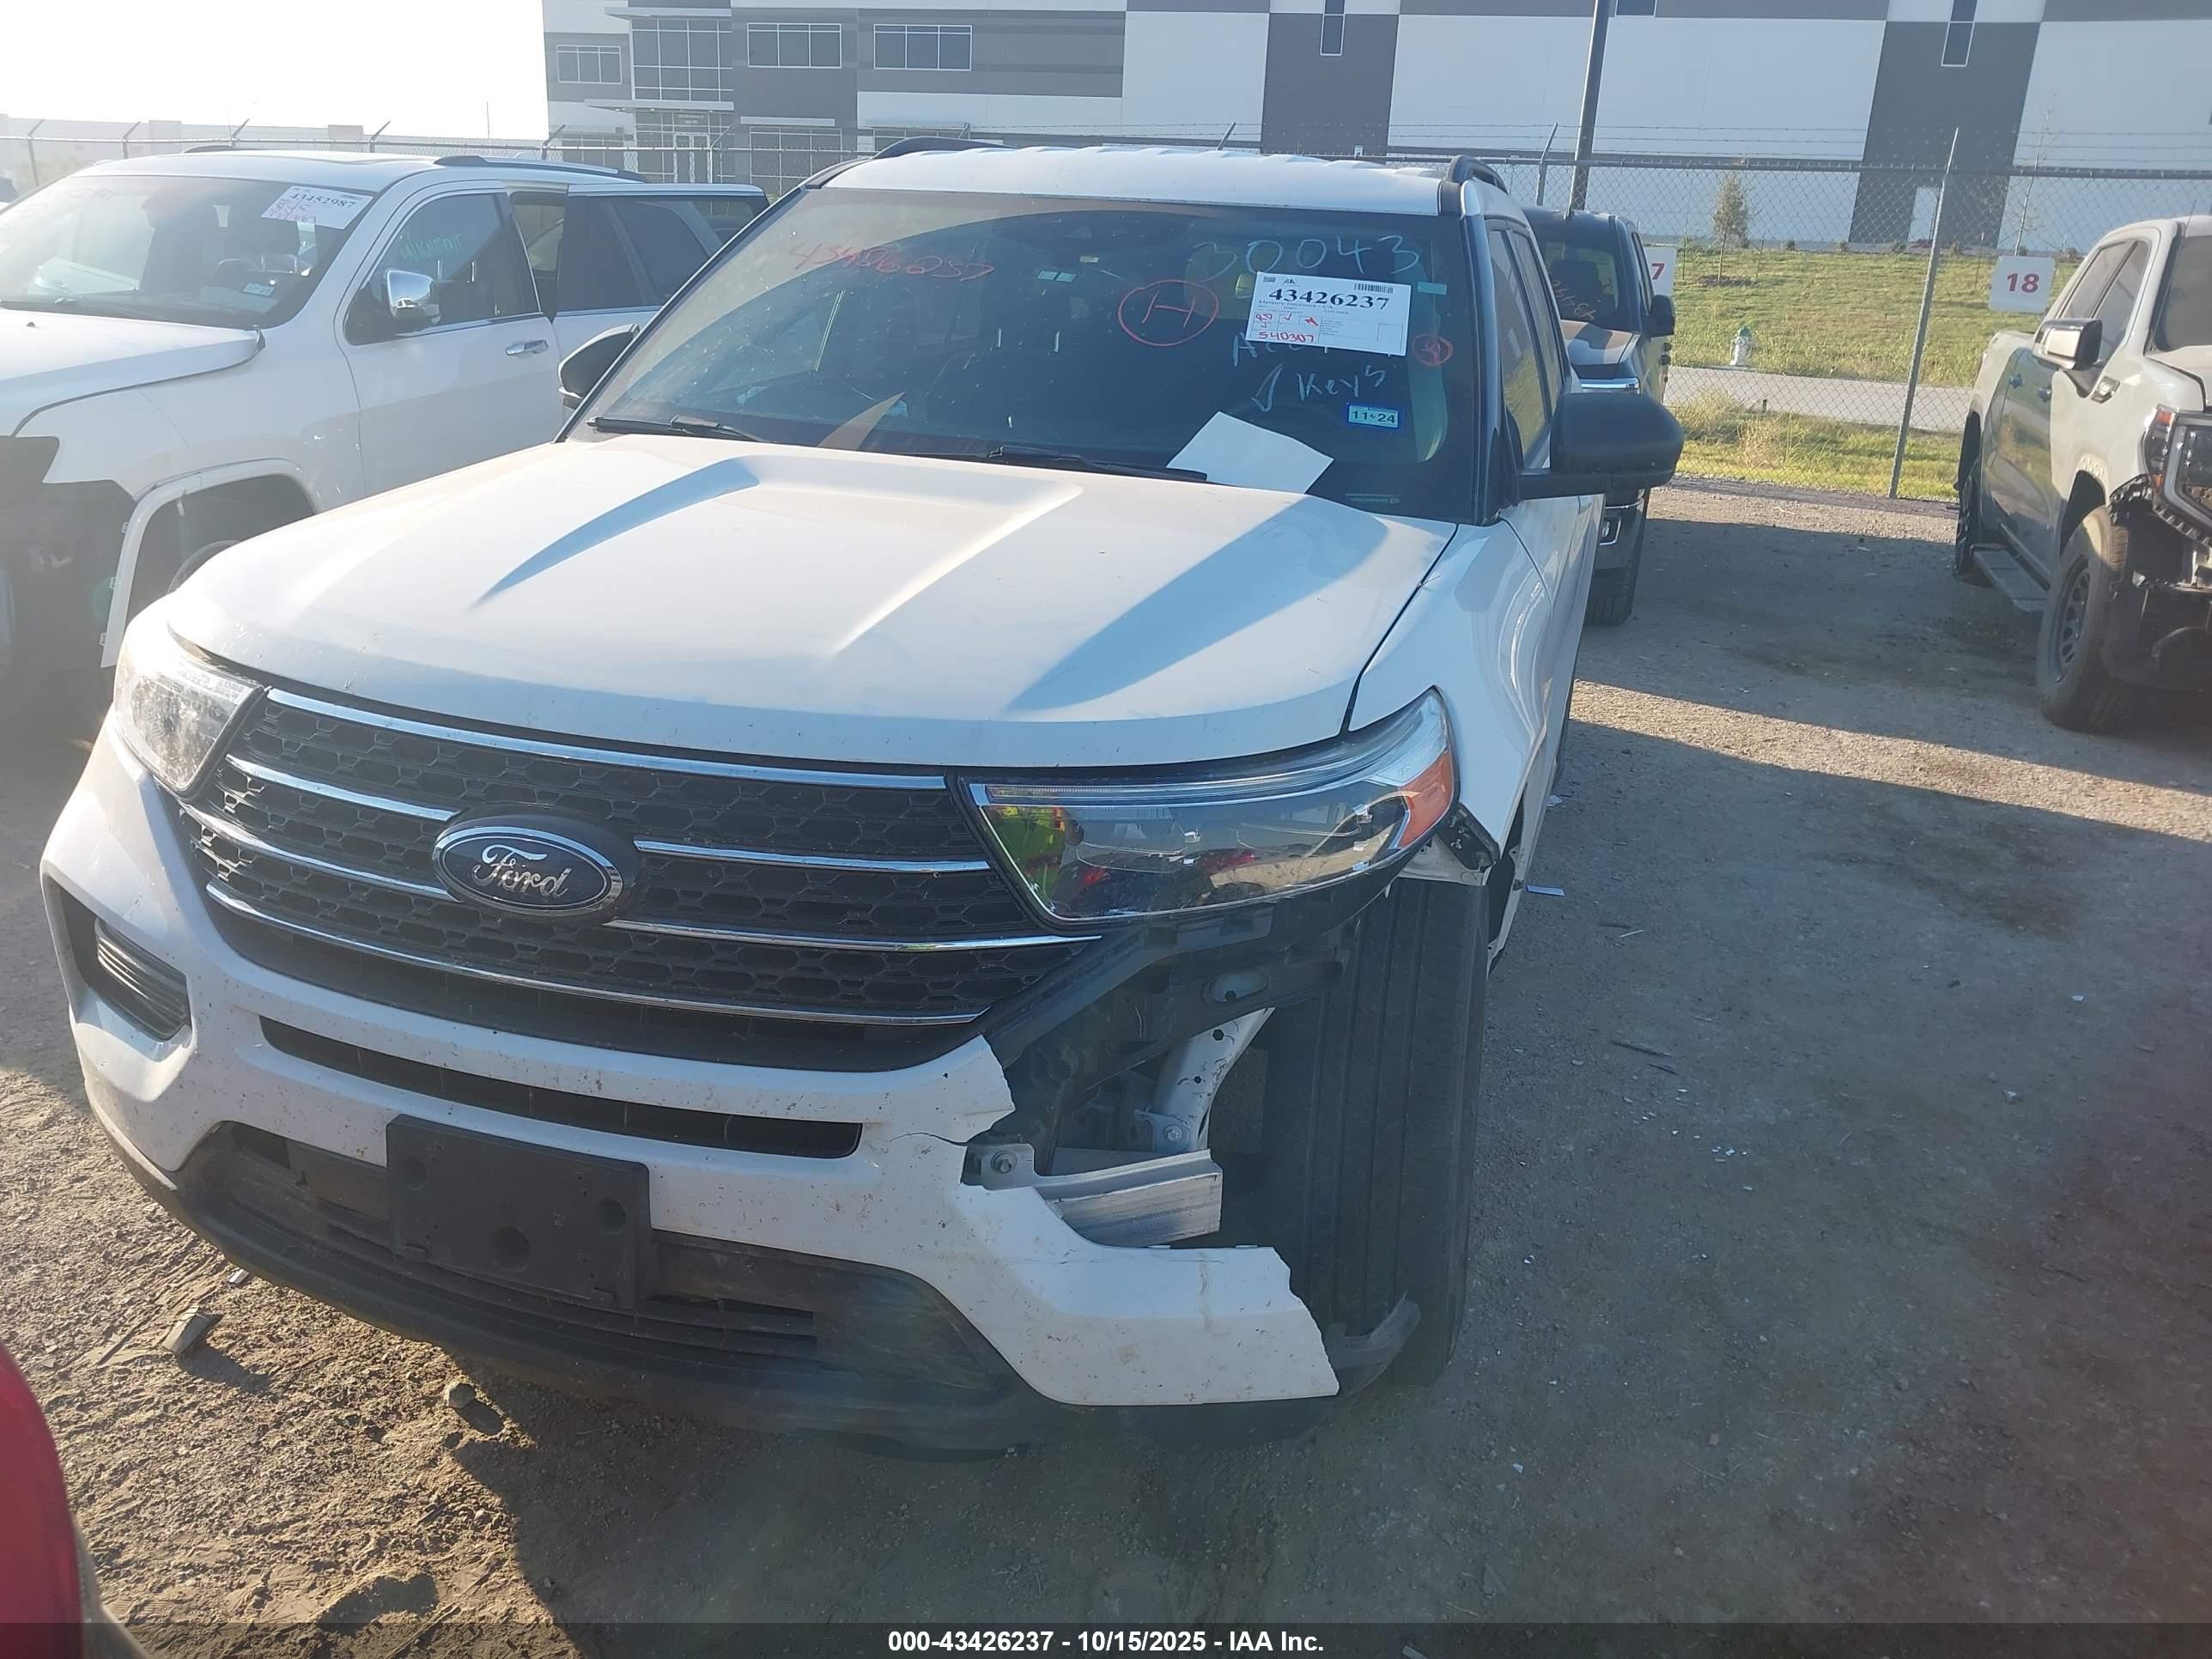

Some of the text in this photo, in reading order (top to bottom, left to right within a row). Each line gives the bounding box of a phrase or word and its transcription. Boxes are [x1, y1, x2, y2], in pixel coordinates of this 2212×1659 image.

[1192, 234, 1419, 283] 30043
[1651, 262, 1665, 281] 7
[2007, 272, 2040, 293] 18
[1268, 288, 1390, 310] 43426237
[1294, 364, 1387, 402] Keys
[472, 844, 573, 896] Ford
